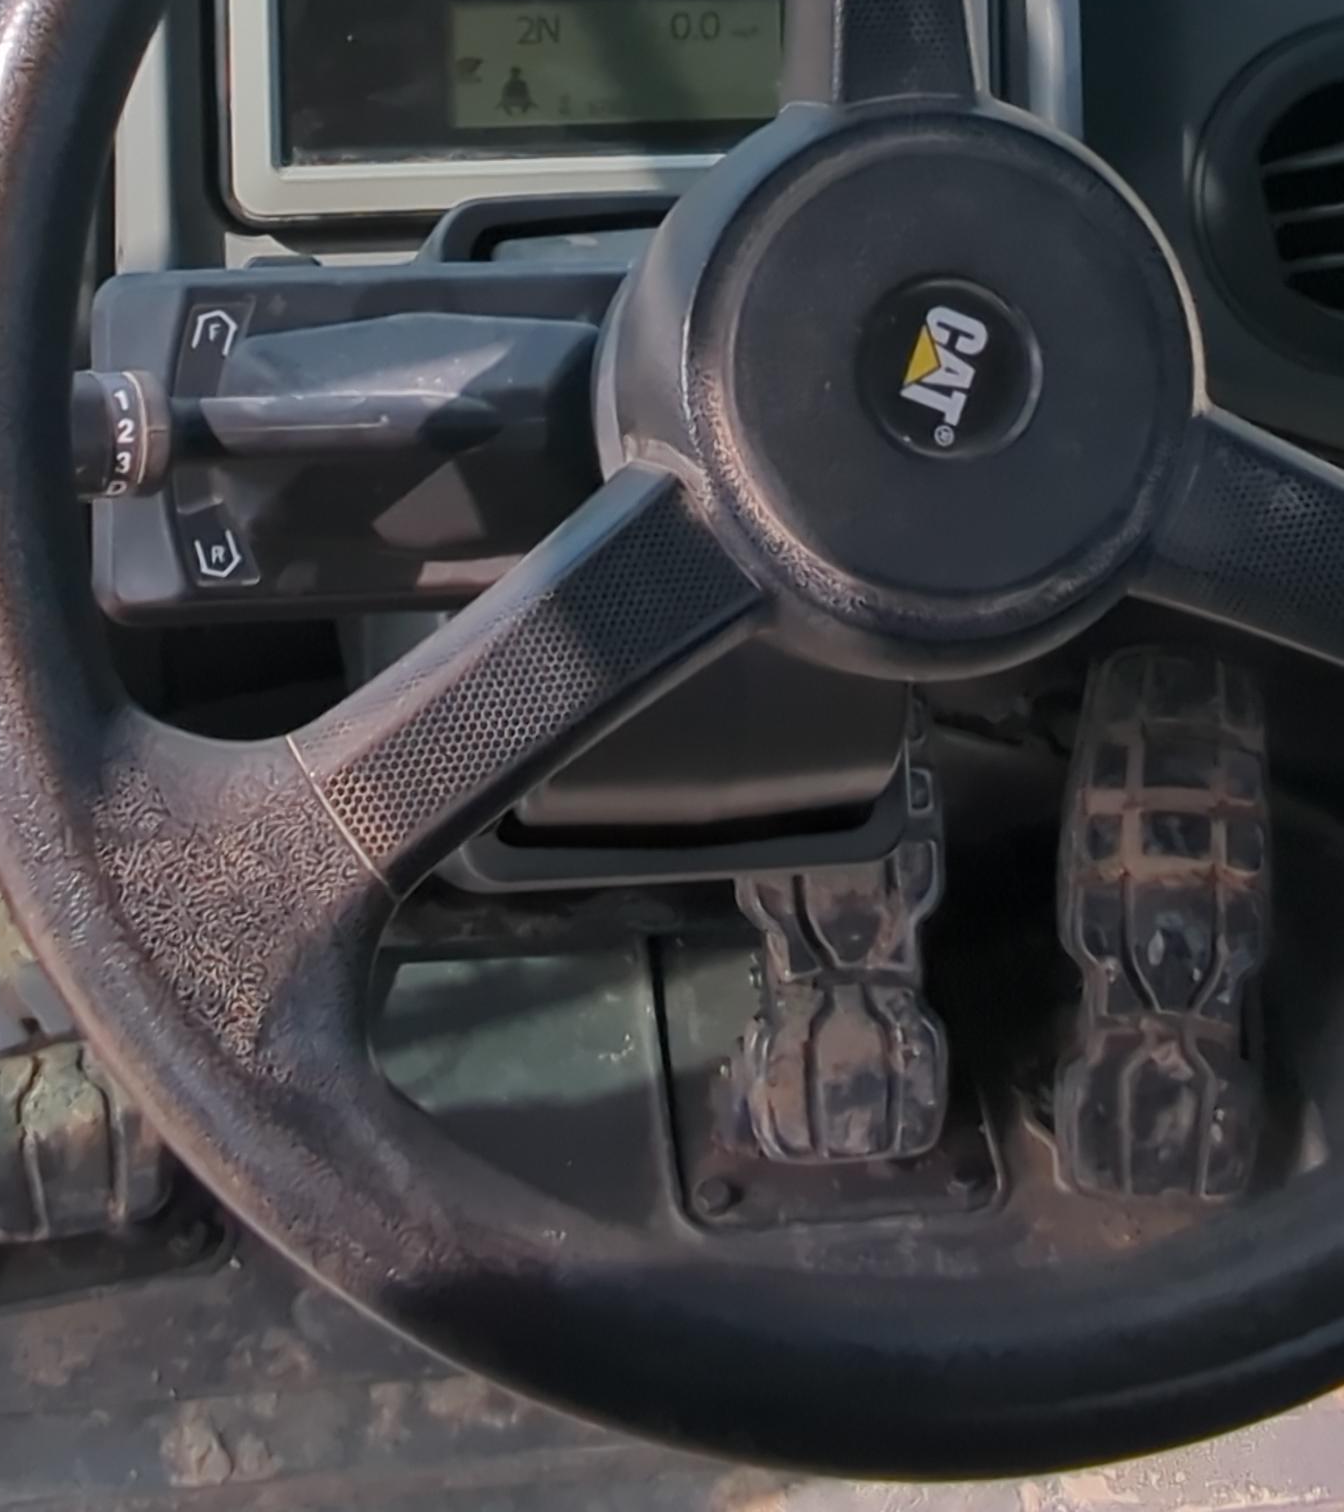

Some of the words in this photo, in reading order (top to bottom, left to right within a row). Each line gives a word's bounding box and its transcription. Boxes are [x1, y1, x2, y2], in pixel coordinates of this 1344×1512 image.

[209, 323, 221, 341] F
[113, 390, 128, 410] 1
[116, 419, 135, 443] 2
[116, 452, 132, 474] 3
[211, 545, 225, 563] R
